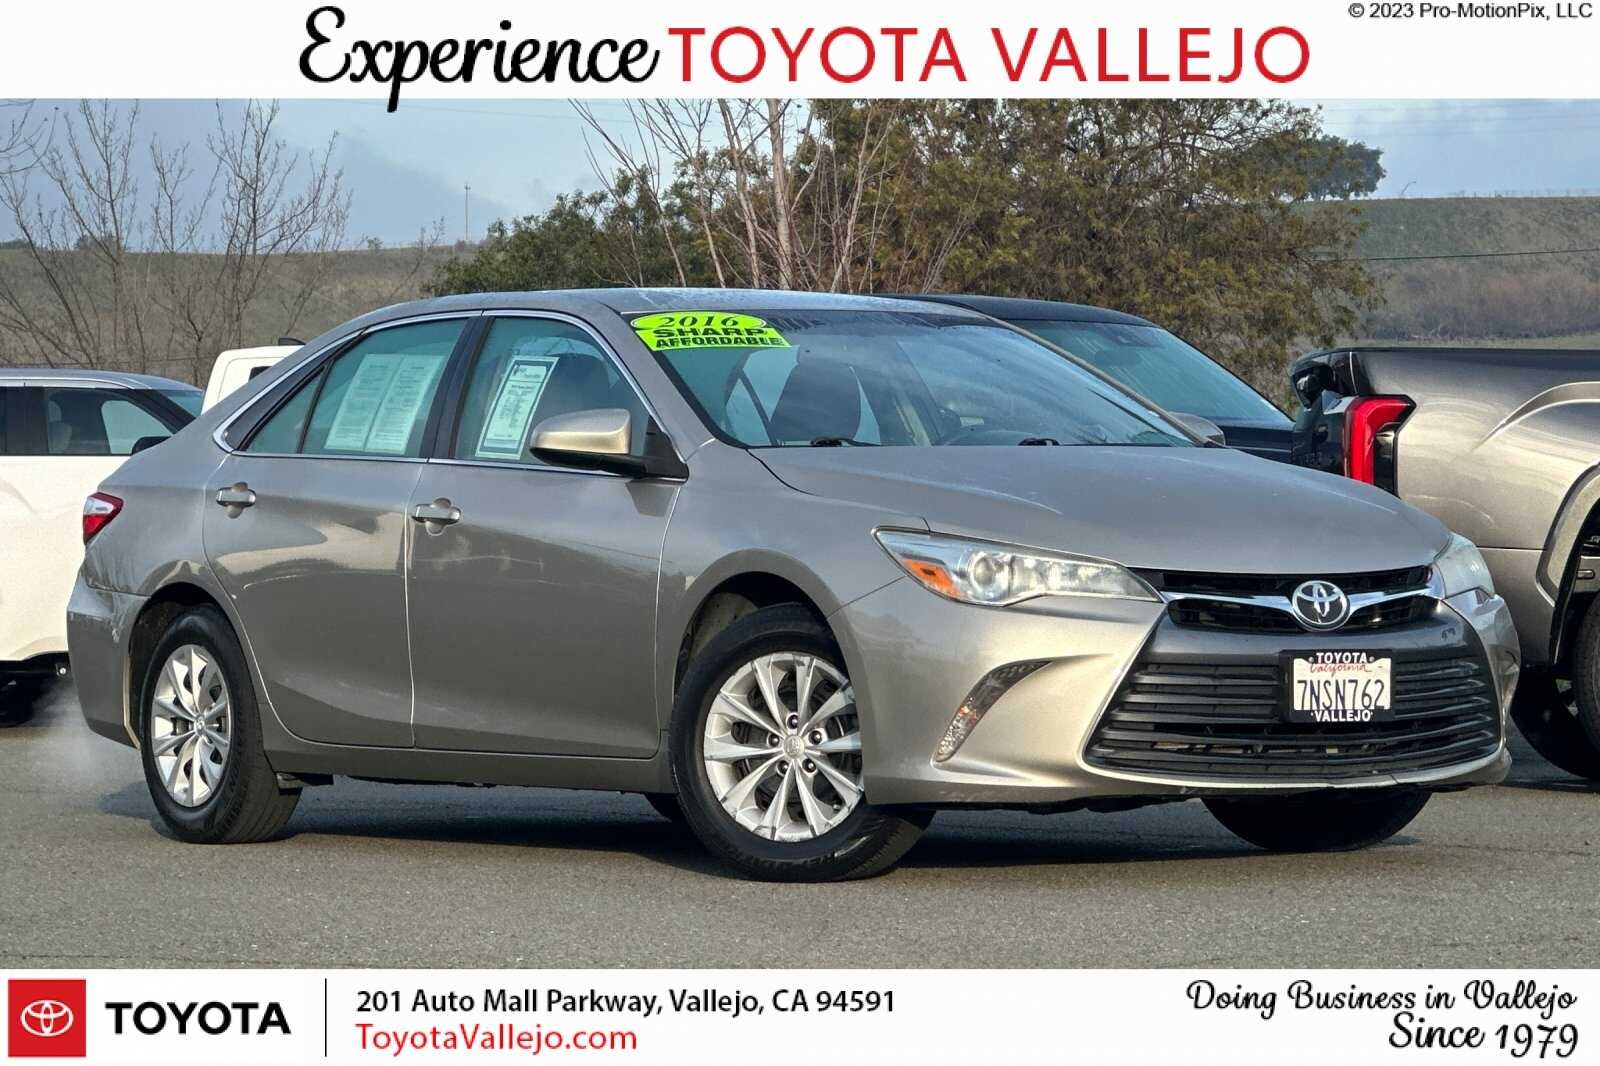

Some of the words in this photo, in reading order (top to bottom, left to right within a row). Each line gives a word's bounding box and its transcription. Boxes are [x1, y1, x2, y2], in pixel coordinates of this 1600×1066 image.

[660, 315, 739, 328] 2016
[653, 327, 767, 338] SHARP
[656, 336, 785, 349] AFFORDABLE
[1316, 652, 1367, 664] TOYOTA
[1310, 663, 1373, 677] California
[1297, 679, 1385, 710] 7NSN762
[1314, 710, 1371, 722] VALLEJO
